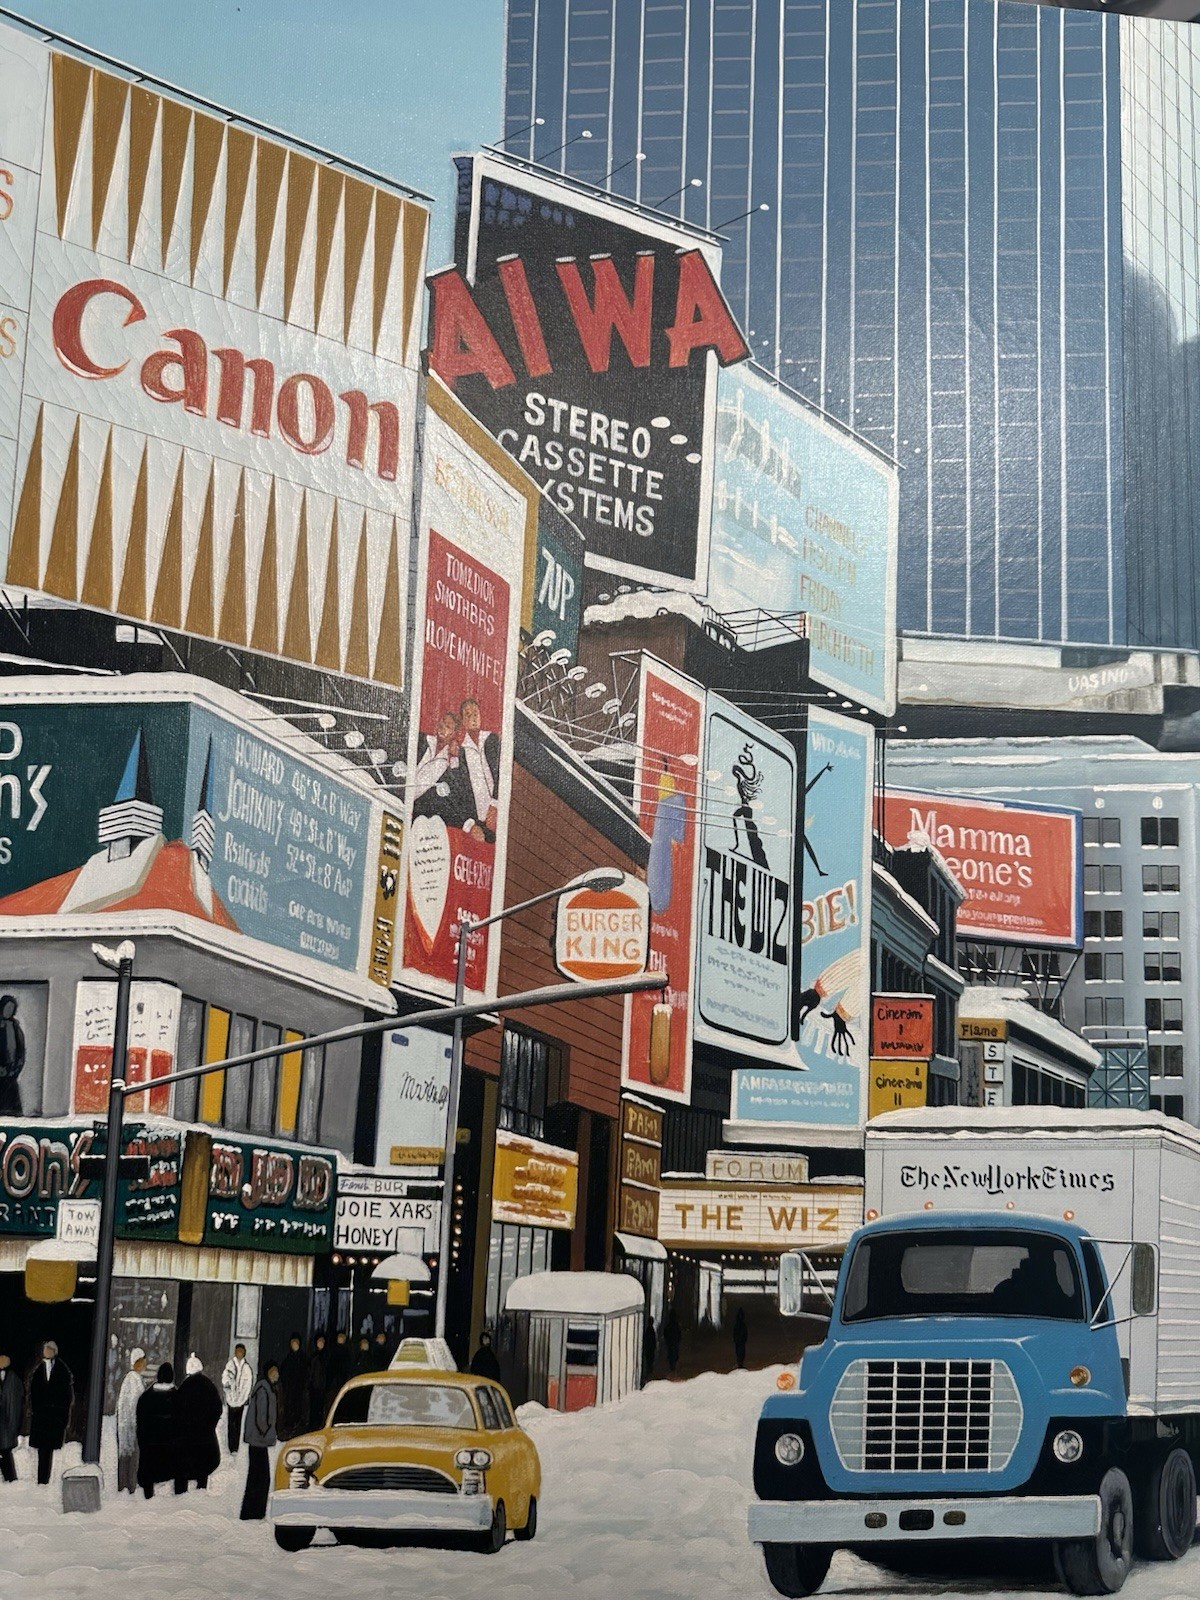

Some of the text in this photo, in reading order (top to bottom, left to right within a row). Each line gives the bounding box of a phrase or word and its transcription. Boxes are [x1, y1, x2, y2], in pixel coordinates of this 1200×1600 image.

[428, 248, 747, 390] AIWA
[52, 278, 401, 481] Canon
[524, 392, 651, 459] STEREO
[498, 428, 664, 500] CASSETTE
[235, 733, 284, 785] HOWARD
[909, 808, 1032, 858] Mamma
[946, 857, 1033, 889] eone's
[705, 849, 789, 966] THE WIZ
[566, 911, 643, 933] BURGER
[565, 935, 642, 960] KING
[961, 1024, 999, 1037] Flame
[712, 1160, 806, 1179] FORUM
[900, 1165, 940, 1190] The
[943, 1165, 988, 1190] New
[1042, 1165, 1115, 1192] Times
[374, 1180, 404, 1194] BUR
[68, 1209, 96, 1220] TOW
[337, 1201, 433, 1219] JOIE XARS
[674, 1204, 839, 1231] THE WIZ
[65, 1224, 97, 1237] AWAY
[336, 1225, 394, 1247] HONEY
